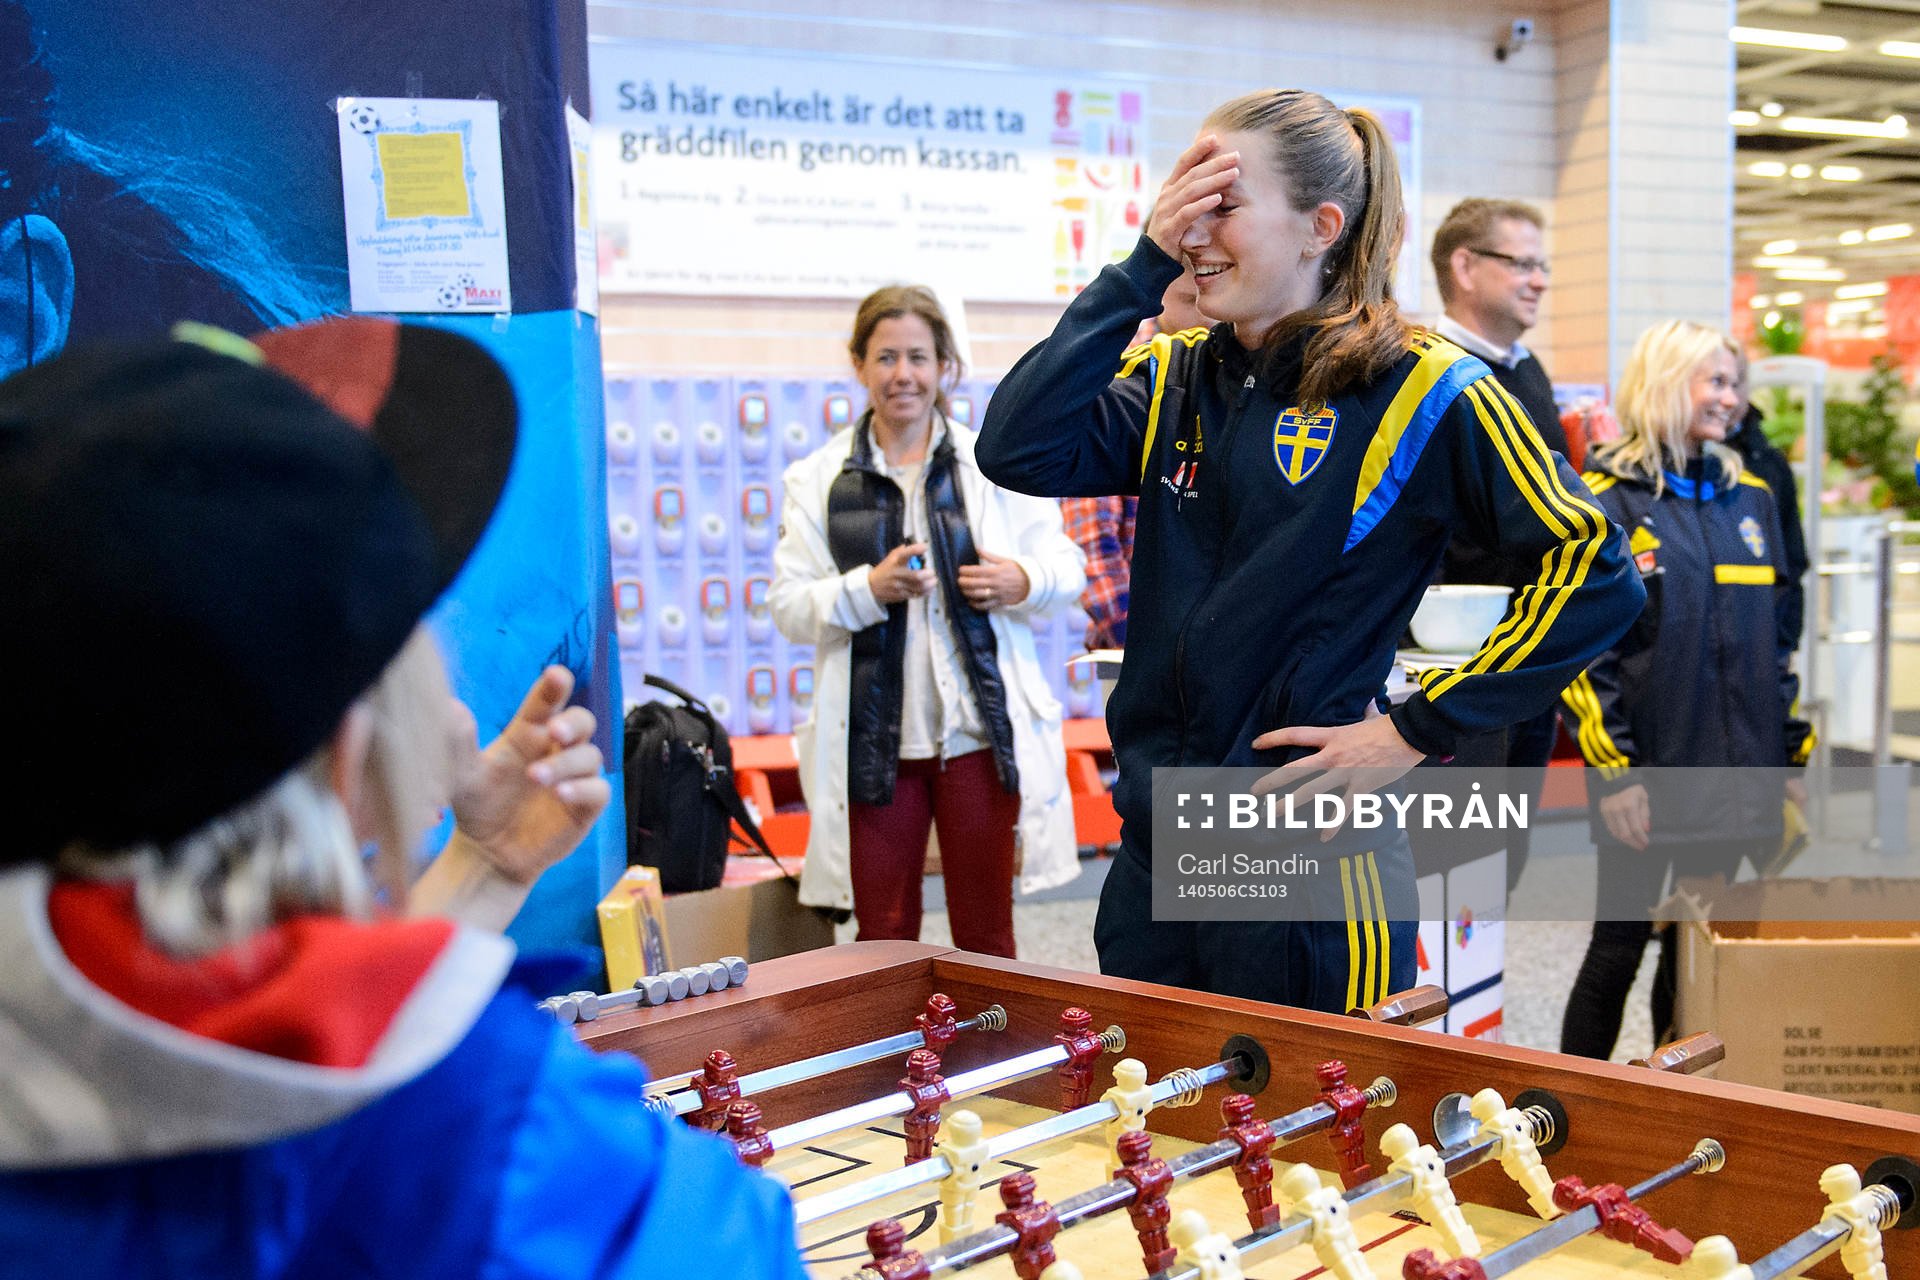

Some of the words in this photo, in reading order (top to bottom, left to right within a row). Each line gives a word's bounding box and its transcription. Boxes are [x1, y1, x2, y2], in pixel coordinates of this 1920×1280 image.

[618, 80, 657, 112] Så
[669, 79, 722, 115] här
[734, 87, 834, 122] enkelt
[844, 94, 874, 126] är
[884, 95, 935, 129] det
[944, 105, 986, 132] att
[996, 107, 1024, 134] ta
[620, 124, 788, 162] gräddfilen
[799, 140, 908, 172] genom
[916, 138, 1028, 174] kassan.
[1293, 417, 1322, 426] SvFF
